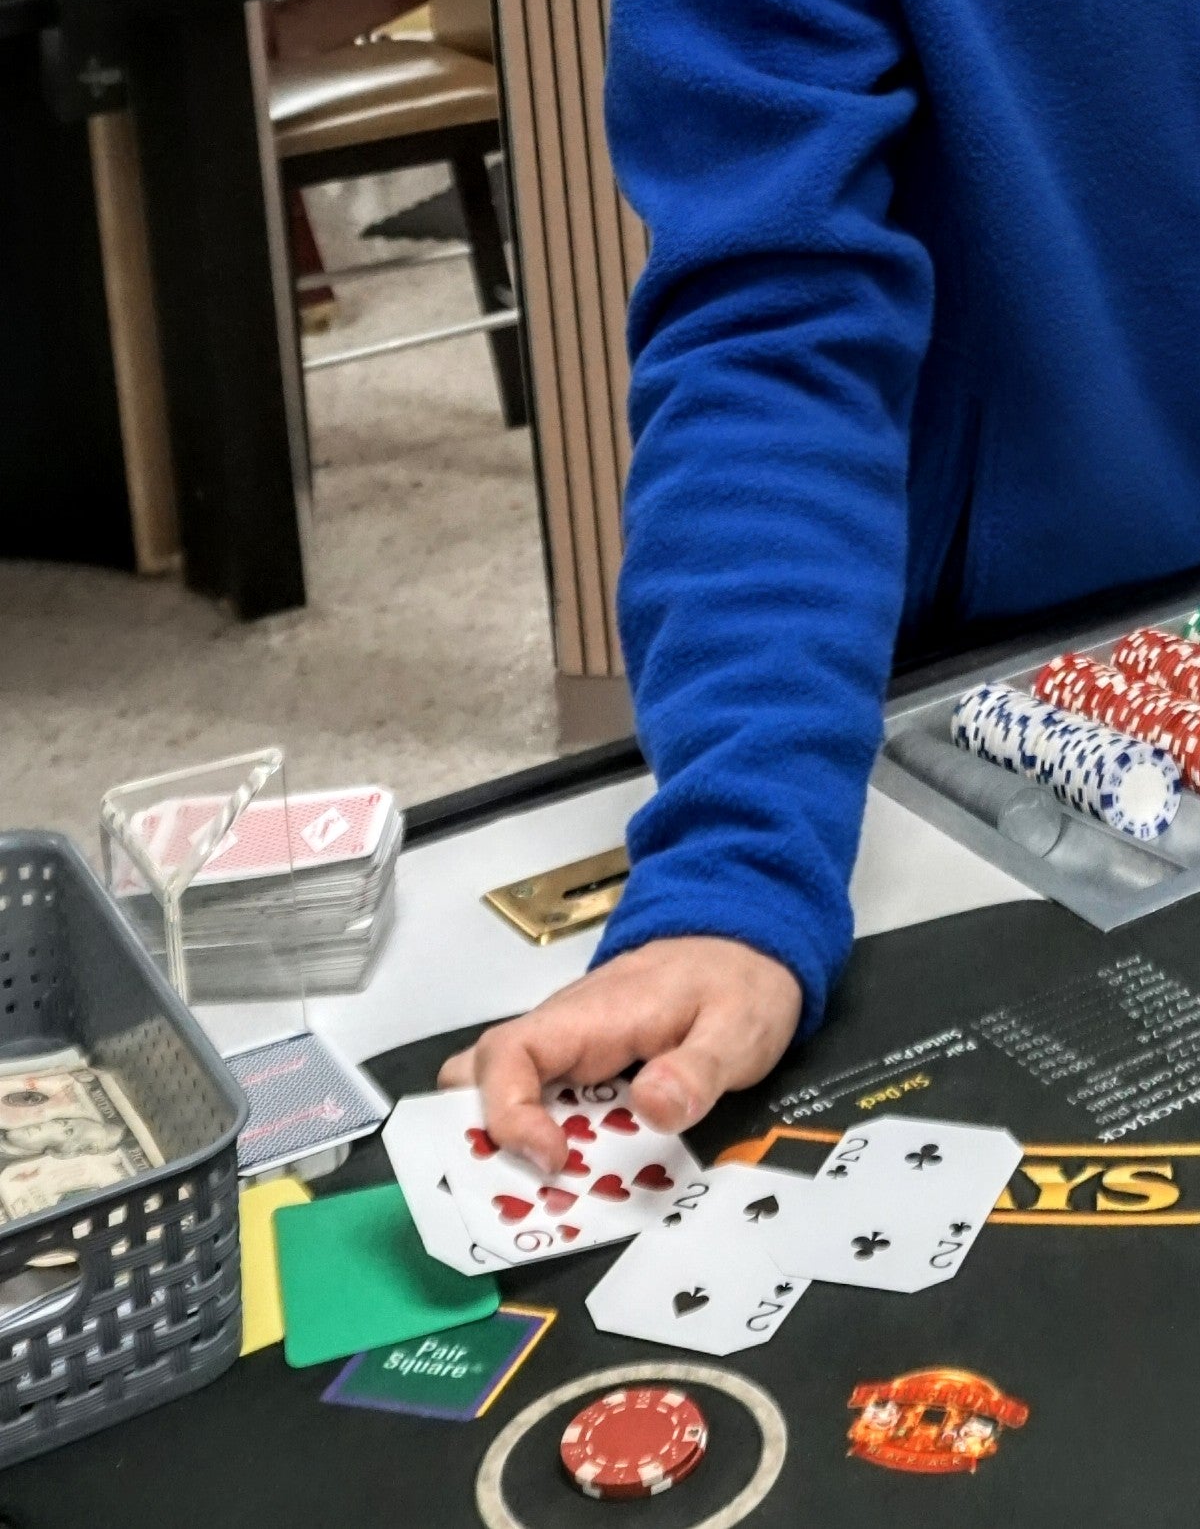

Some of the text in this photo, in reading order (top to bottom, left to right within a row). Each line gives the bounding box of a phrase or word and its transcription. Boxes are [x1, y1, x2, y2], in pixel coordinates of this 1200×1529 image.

[837, 1137, 869, 1163] 2
[673, 1183, 710, 1210] 2
[994, 1159, 1180, 1212] YS
[929, 1240, 963, 1269] 2
[746, 1301, 784, 1332] 2
[415, 1337, 468, 1362] Pair
